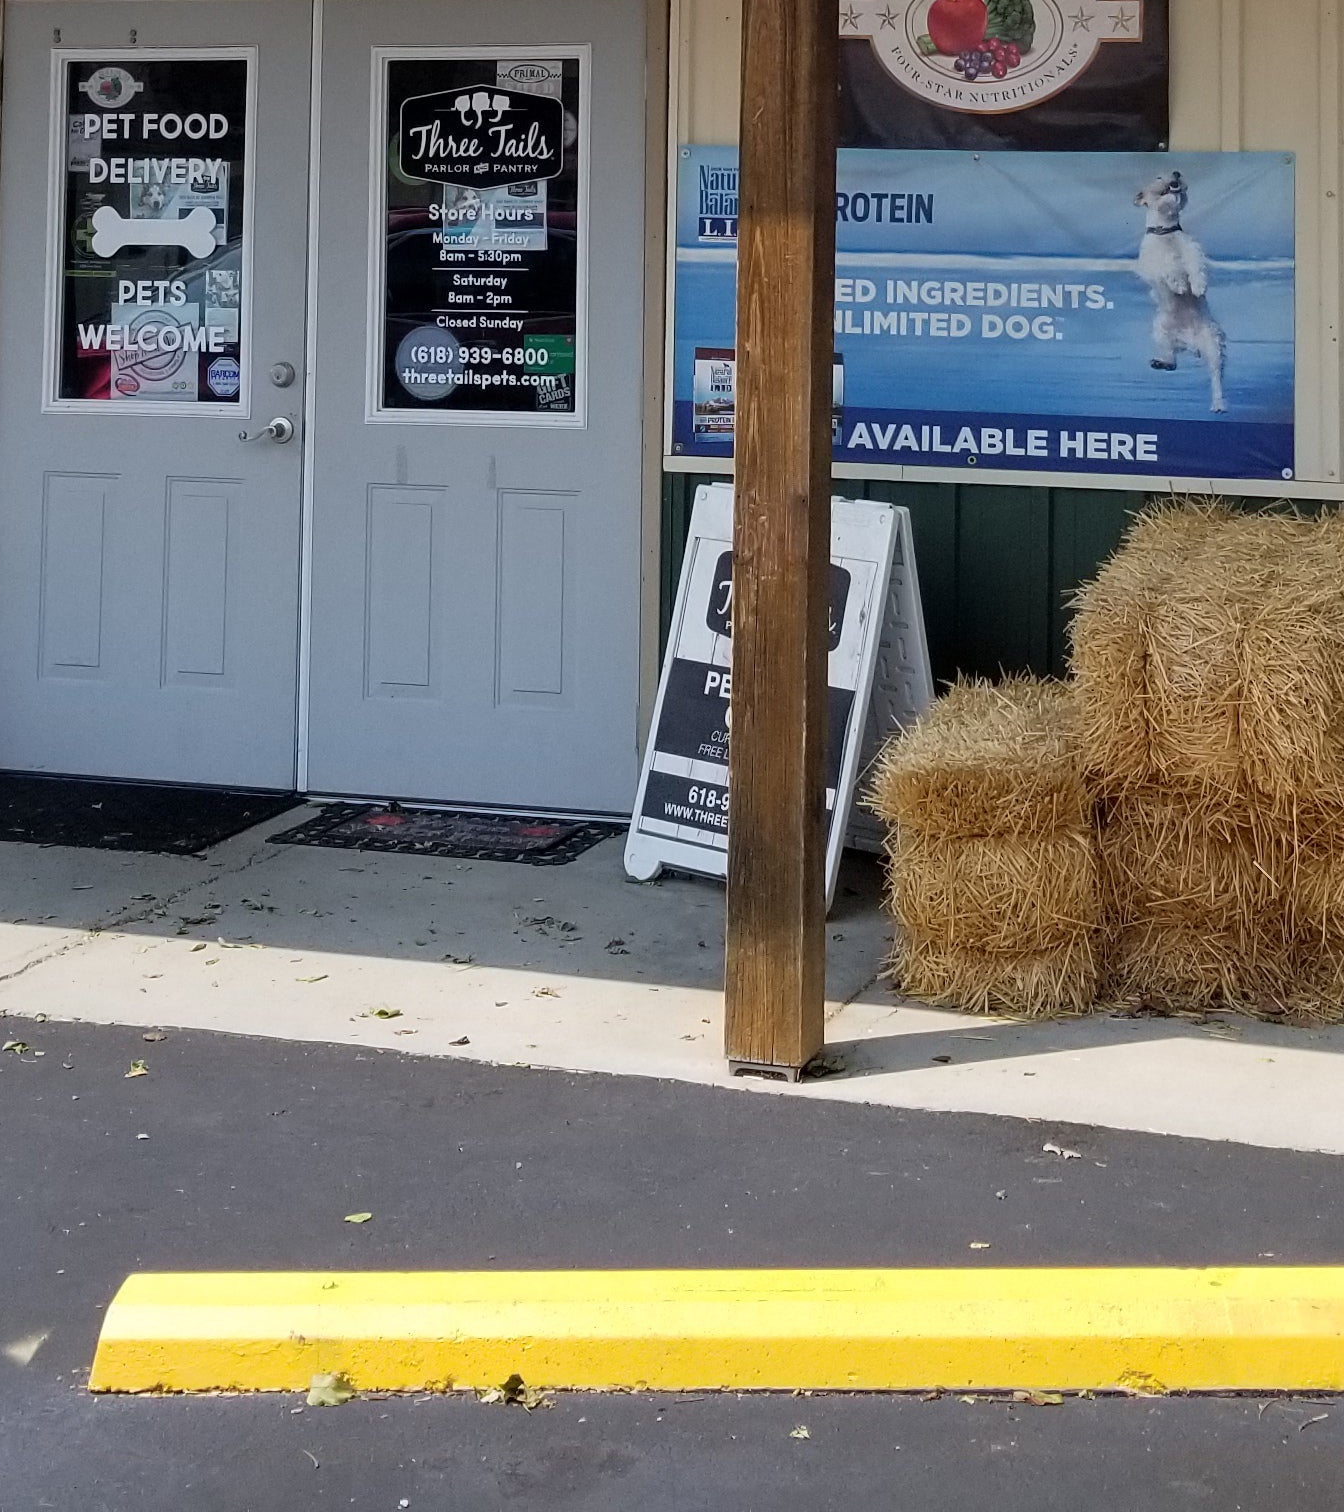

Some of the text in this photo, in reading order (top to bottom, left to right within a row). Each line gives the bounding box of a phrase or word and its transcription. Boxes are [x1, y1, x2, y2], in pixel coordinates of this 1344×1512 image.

[514, 69, 546, 78] PRIMAL
[84, 113, 136, 140] PET
[142, 113, 229, 140] FOOD
[409, 119, 555, 160] Three Tails
[89, 157, 223, 185] DELIVERY
[424, 163, 470, 173] PARLOR
[493, 163, 539, 173] PANTRY
[699, 164, 934, 224] Natu ROTEIN
[699, 190, 738, 216] Bala
[428, 203, 534, 222] Store Hours
[432, 232, 480, 247] Monday
[491, 232, 530, 247] Friday
[439, 250, 465, 262] 8am
[477, 250, 522, 265] 5:30pm
[452, 274, 508, 289] Saturday
[118, 280, 187, 307] PETS
[448, 292, 474, 304] 8am
[485, 292, 512, 307] 2pm
[886, 279, 1114, 310] INGREDIENTS.
[436, 315, 524, 331] Closed Sunday
[834, 309, 1064, 341] LIMITED DOG.
[77, 323, 225, 353] WELCOME
[410, 346, 549, 365] (618) 939-6800
[402, 368, 556, 389] threetailspets.com
[538, 387, 571, 404] CARDS
[847, 422, 1158, 461] AVAILABLE HERE
[703, 670, 731, 699] PE
[698, 743, 724, 759] FREE
